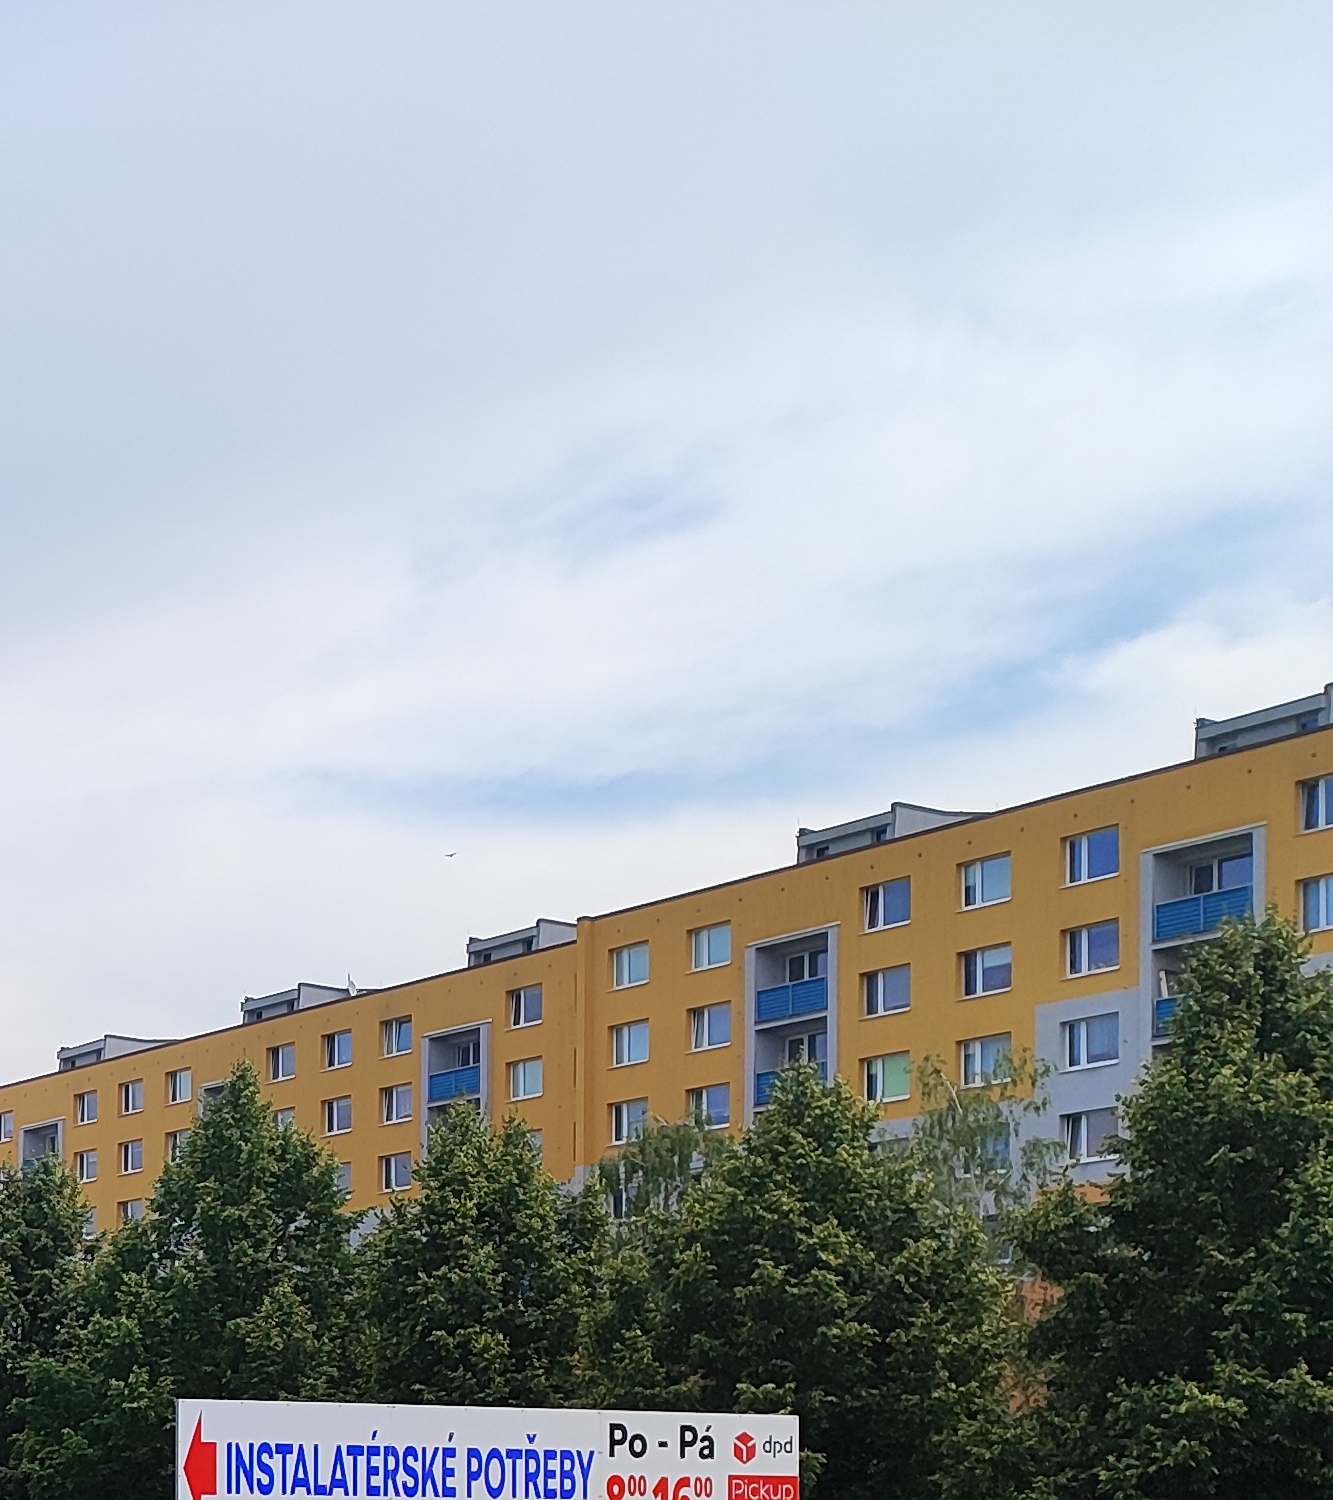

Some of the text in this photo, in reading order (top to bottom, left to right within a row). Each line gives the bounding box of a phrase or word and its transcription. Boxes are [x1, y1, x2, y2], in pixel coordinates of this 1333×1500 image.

[608, 1422, 648, 1458] Po
[679, 1424, 715, 1460] Pá
[762, 1435, 793, 1459] dpd
[226, 1429, 595, 1500] INSTALATÉRSKÉ POTŘEBY
